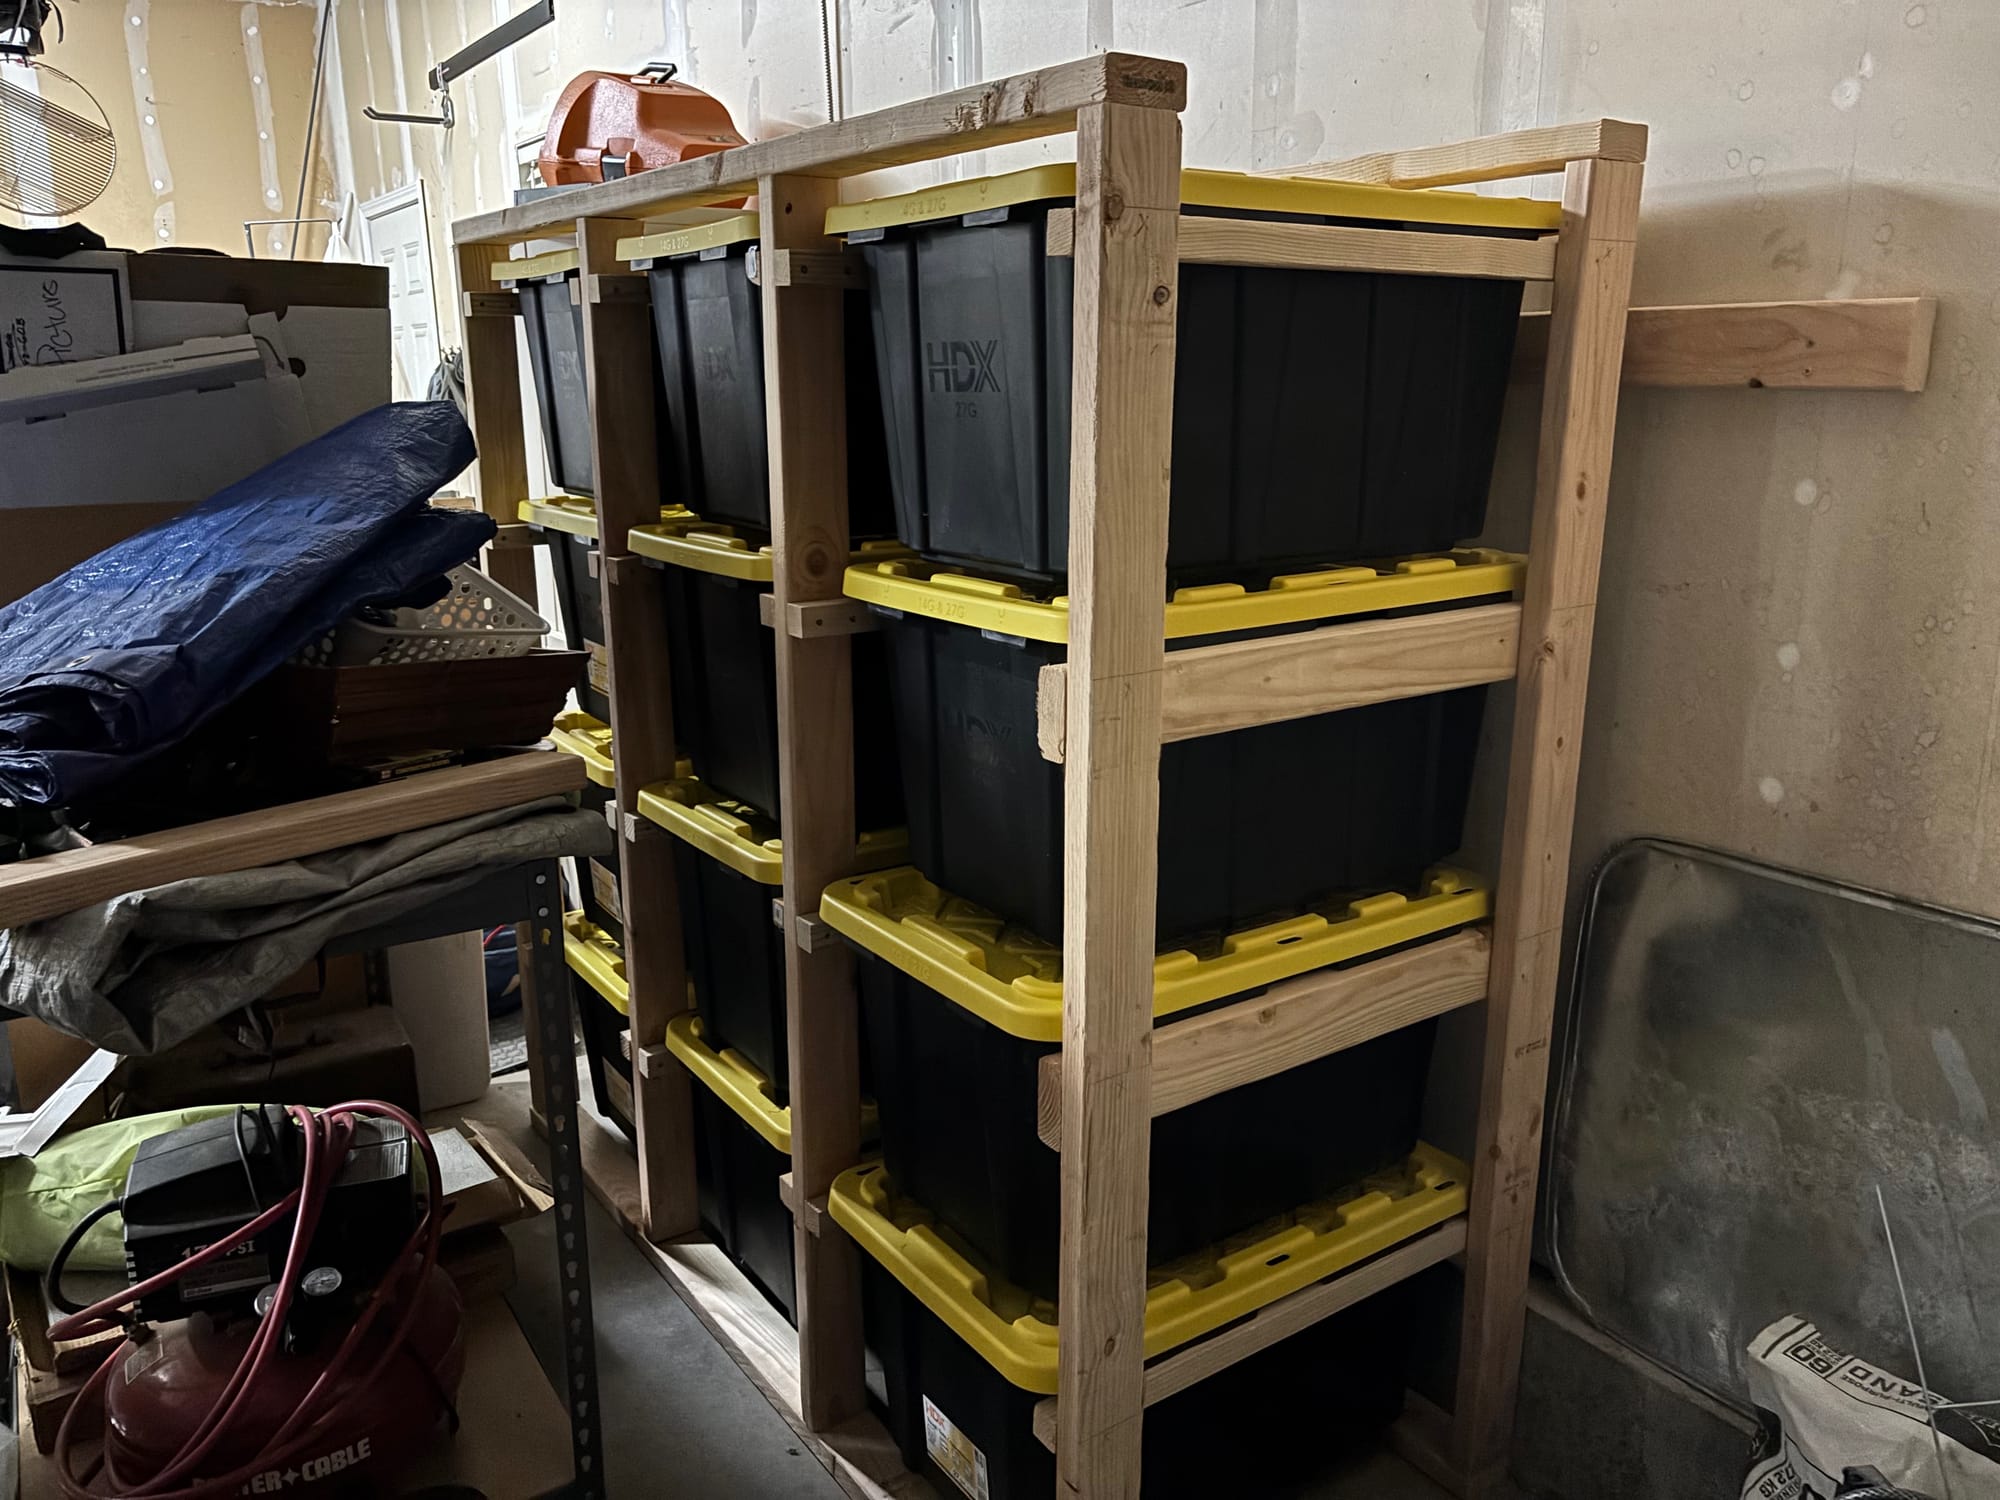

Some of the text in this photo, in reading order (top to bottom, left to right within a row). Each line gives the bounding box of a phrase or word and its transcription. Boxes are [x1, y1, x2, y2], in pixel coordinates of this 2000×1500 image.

[927, 339, 1001, 393] HDX
[1791, 1344, 1833, 1374] 60
[302, 1437, 371, 1482] CABLE
[1759, 1478, 1778, 1498] KG
